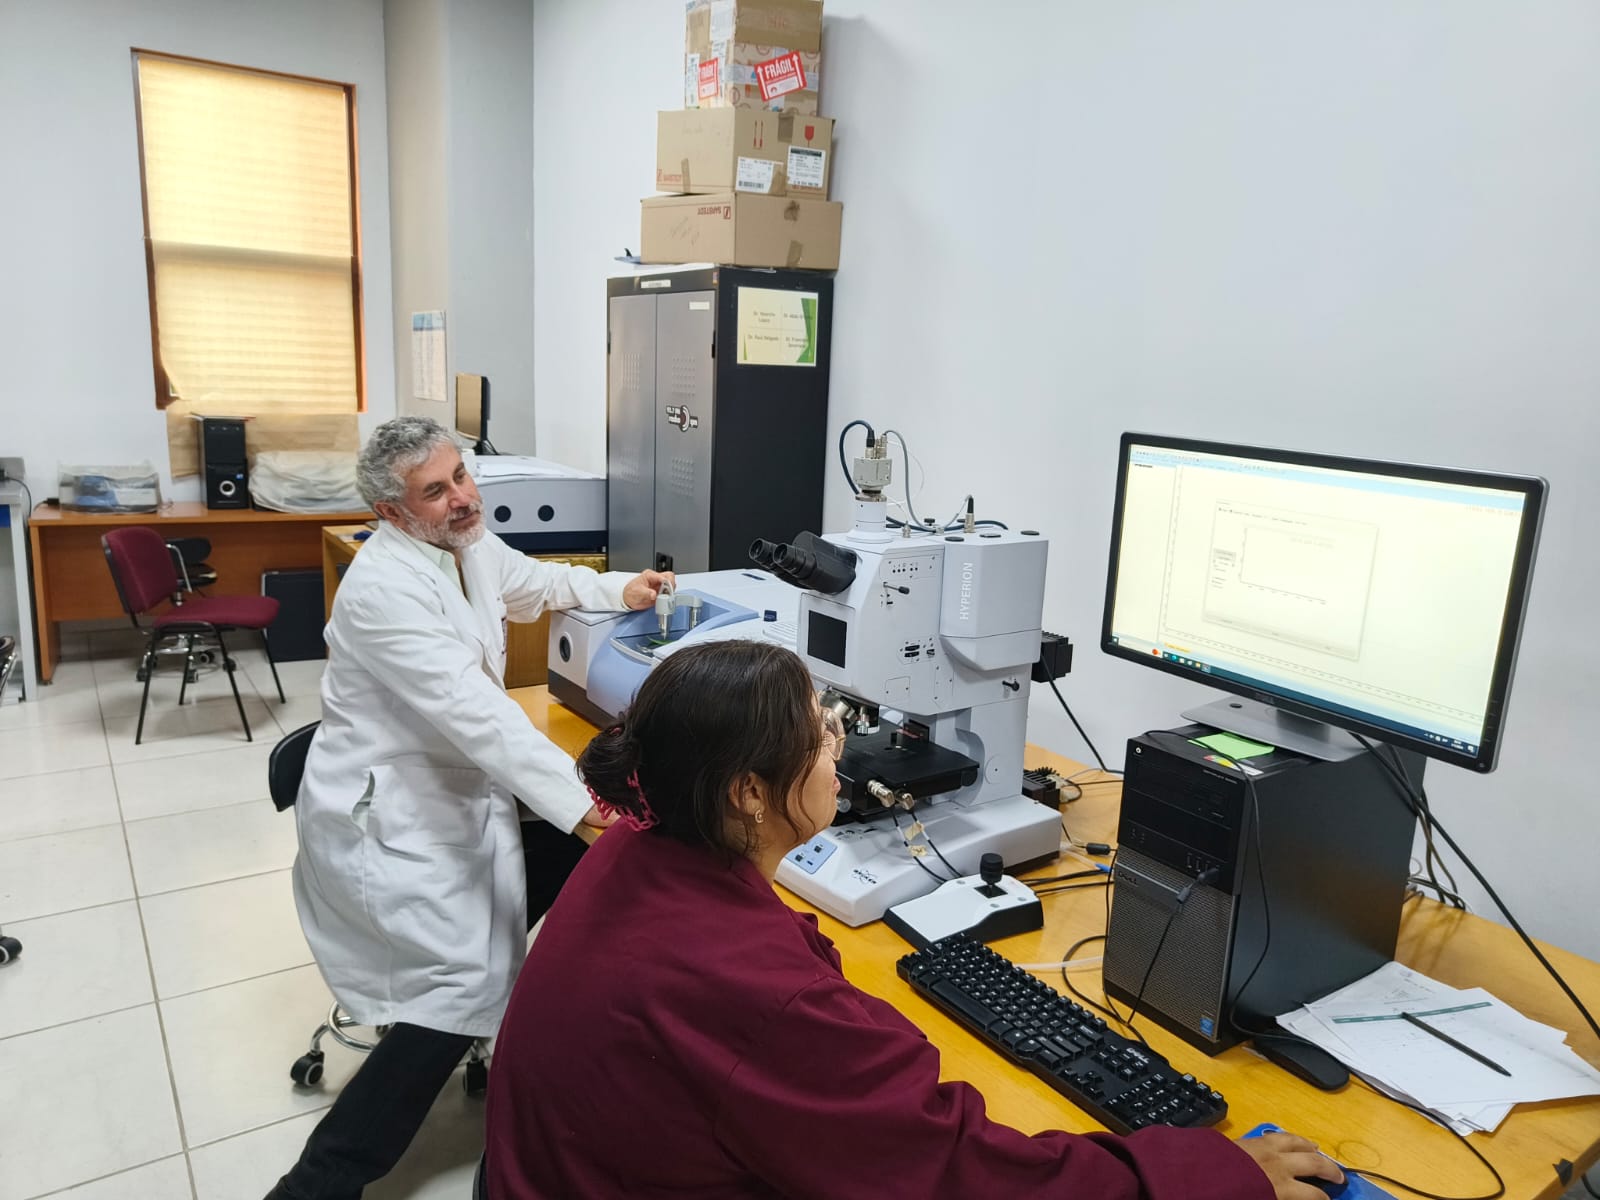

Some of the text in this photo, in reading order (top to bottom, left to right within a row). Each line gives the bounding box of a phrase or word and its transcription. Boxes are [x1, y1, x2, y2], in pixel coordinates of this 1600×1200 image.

[764, 57, 795, 79] FRÁGIL
[960, 562, 973, 620] HYPERION
[1126, 1047, 1149, 1064] DELL
